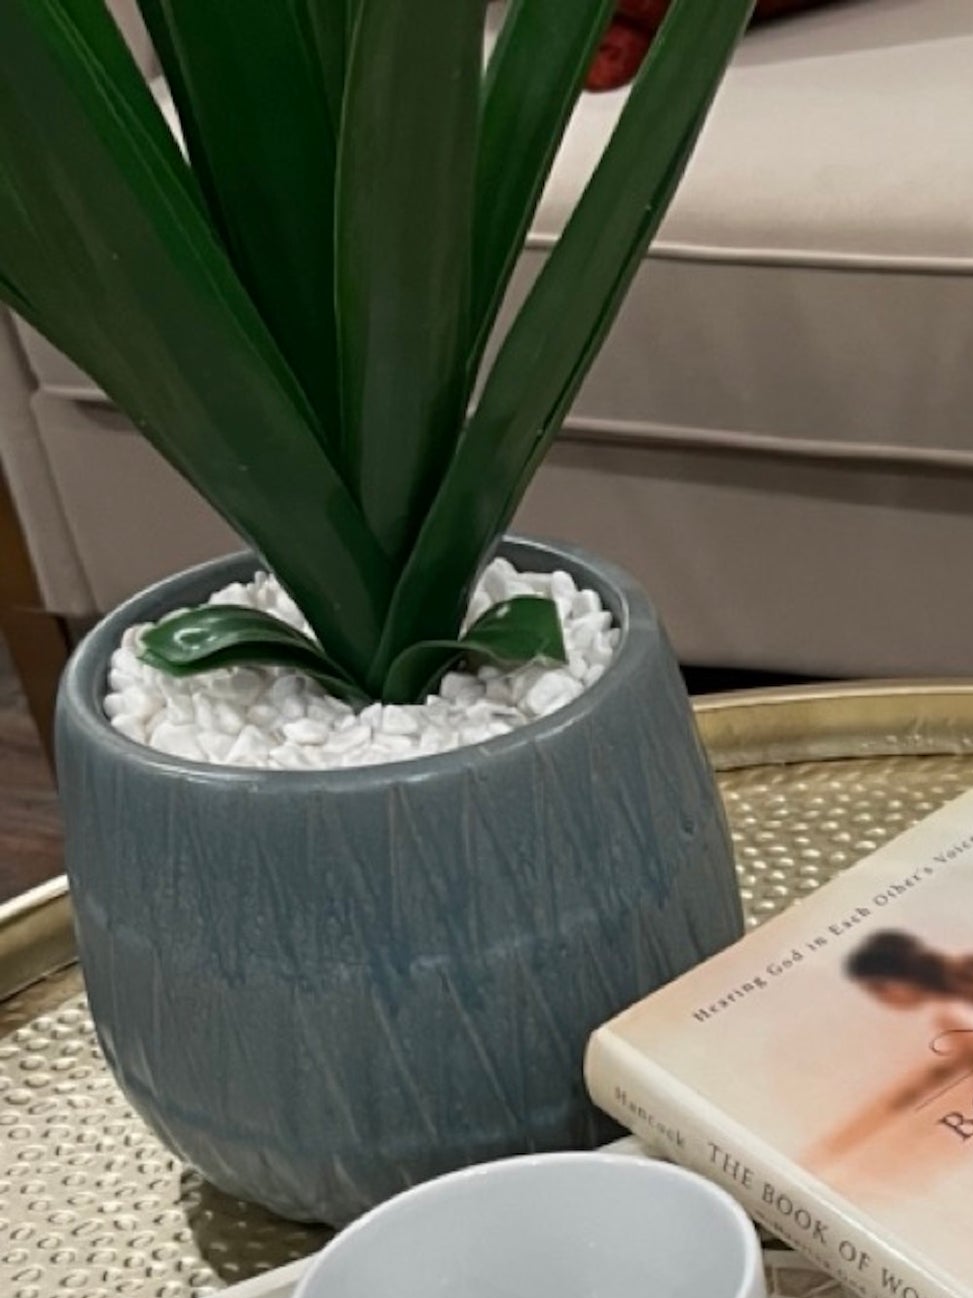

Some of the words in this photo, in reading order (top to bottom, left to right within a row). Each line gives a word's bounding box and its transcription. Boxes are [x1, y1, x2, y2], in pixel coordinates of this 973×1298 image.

[693, 972, 768, 1023] Hearing
[766, 948, 804, 977] God
[808, 935, 828, 952] in
[829, 907, 871, 936] Each
[873, 866, 934, 907] Other's
[615, 1086, 686, 1149] Hancock
[708, 1141, 755, 1189] THE
[762, 1184, 829, 1244] BOOK
[839, 1240, 872, 1271] OF
